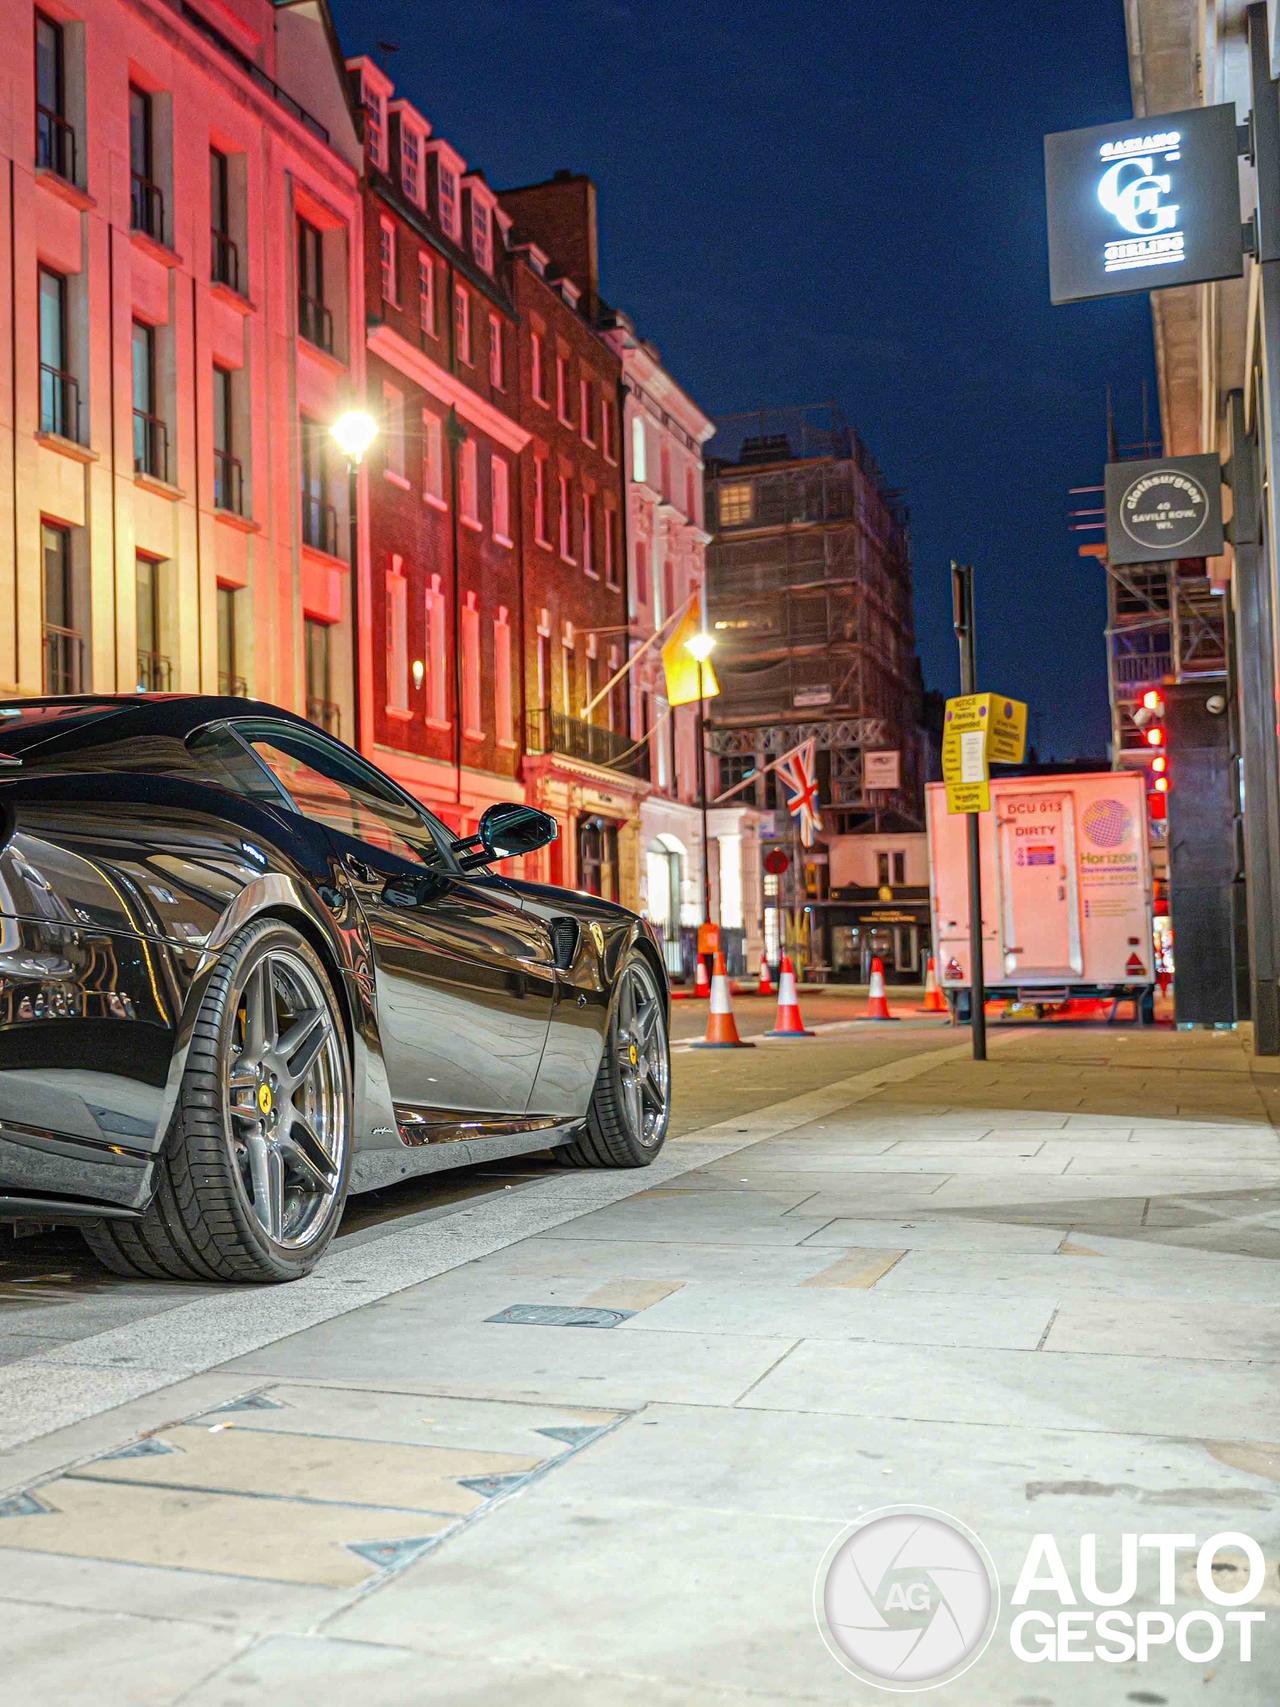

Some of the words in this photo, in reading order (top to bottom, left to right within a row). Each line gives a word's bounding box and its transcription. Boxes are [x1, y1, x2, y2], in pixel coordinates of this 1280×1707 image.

[1104, 236, 1184, 260] GIRLING
[1126, 475, 1203, 510] clothsurgeon
[1131, 512, 1167, 523] SAVILE
[954, 697, 976, 707] NOTICE
[954, 712, 975, 720] Parking
[949, 720, 980, 730] Suspended
[1007, 804, 1035, 814] DCU
[1039, 801, 1062, 812] 013
[1015, 826, 1056, 836] DIRTY
[1080, 851, 1137, 865] Horizon
